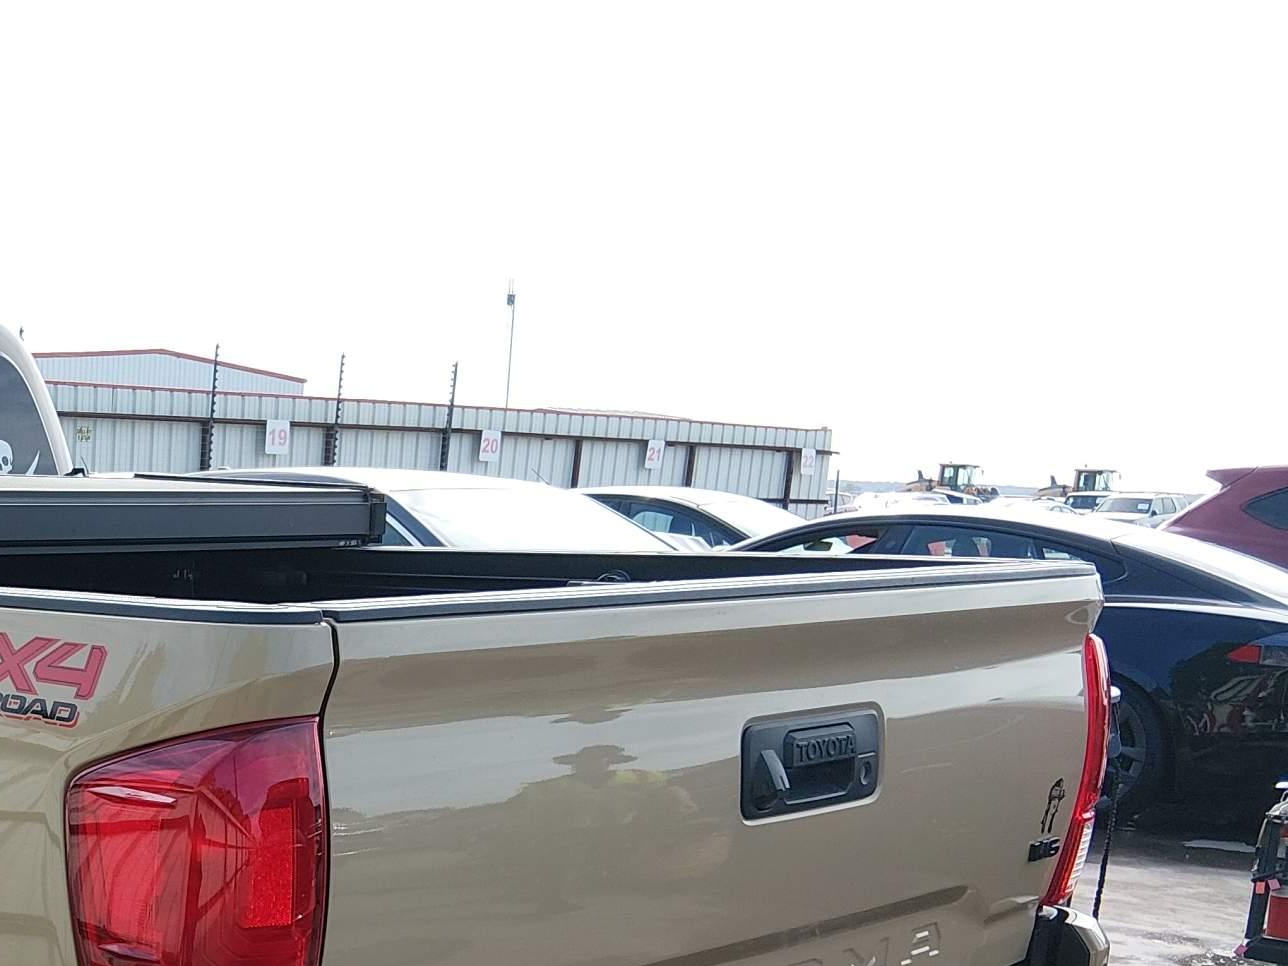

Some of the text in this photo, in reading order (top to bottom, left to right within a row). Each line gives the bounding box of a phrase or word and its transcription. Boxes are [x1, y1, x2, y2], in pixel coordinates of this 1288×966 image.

[268, 428, 288, 447] 19
[482, 437, 500, 455] 20
[647, 446, 662, 462] 21
[802, 454, 815, 469] 22
[795, 734, 857, 763] TOYOTA
